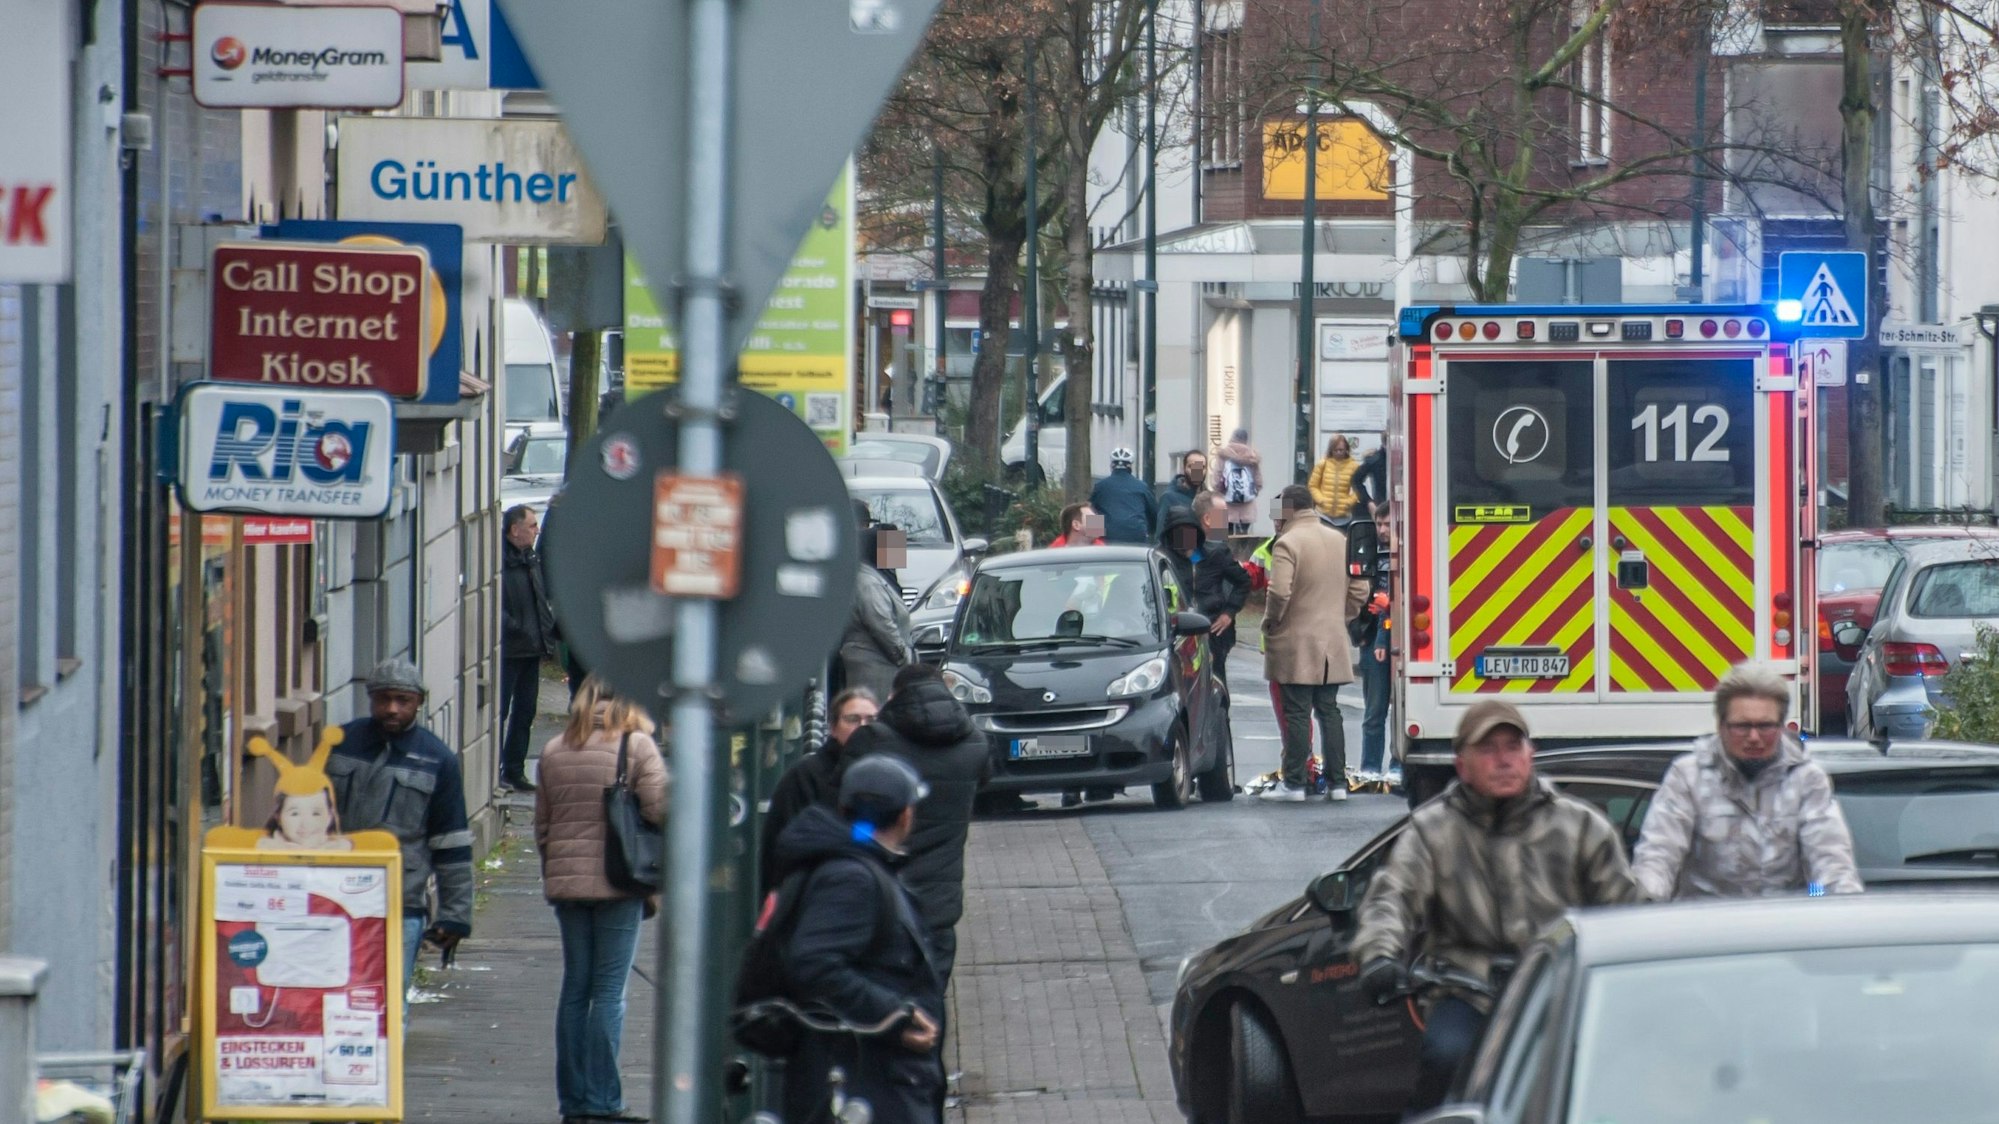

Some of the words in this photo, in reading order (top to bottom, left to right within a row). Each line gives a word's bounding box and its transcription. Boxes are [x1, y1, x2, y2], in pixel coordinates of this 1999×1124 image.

[252, 48, 389, 69] MoneyGram
[252, 72, 329, 83] geldtransfer
[1274, 132, 1331, 151] ADC
[371, 160, 577, 204] Günther
[0, 184, 54, 246] K
[222, 260, 299, 293] Call
[313, 263, 416, 304] Shop
[238, 307, 398, 341] Internet
[261, 354, 374, 386] Kiosk
[209, 399, 371, 485] Ria
[1631, 404, 1730, 462] 112
[204, 487, 271, 501] MONEY
[277, 488, 362, 506] TRANSFER
[1485, 658, 1511, 673] LEV
[1521, 658, 1539, 673] RD
[1542, 658, 1567, 672] 847
[1020, 741, 1029, 755] K
[220, 1041, 305, 1054] EINSTECKEN
[236, 1057, 316, 1070] LOSSURFEN
